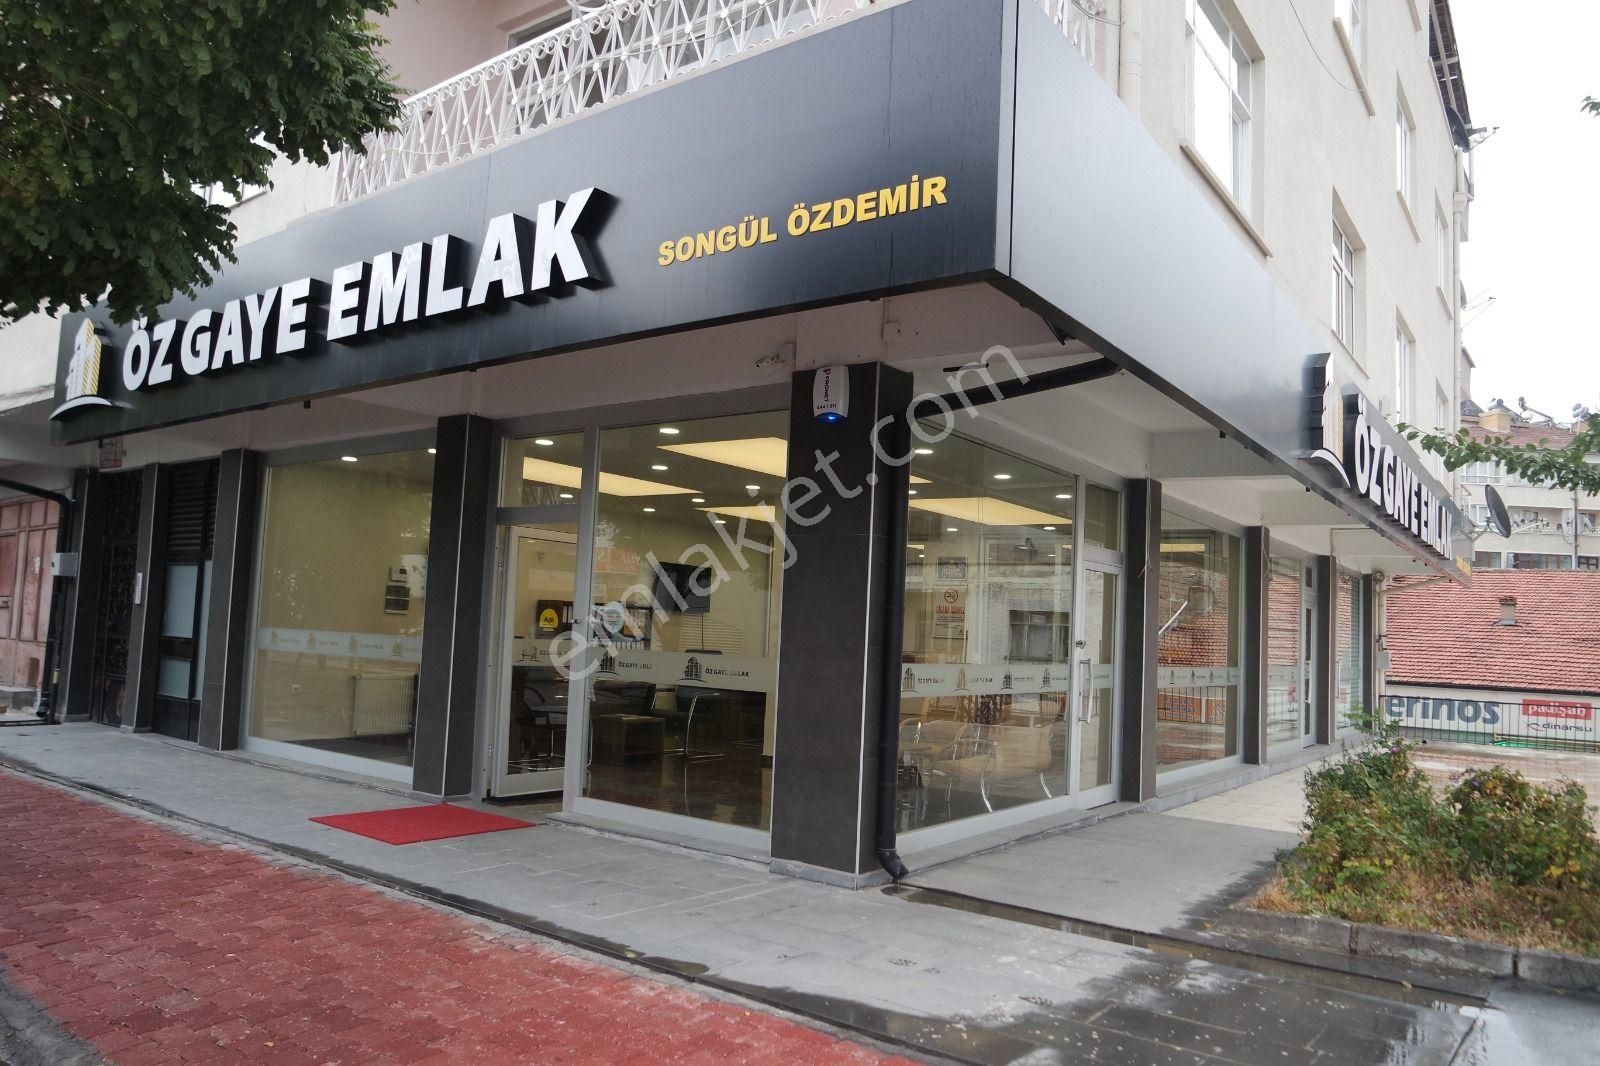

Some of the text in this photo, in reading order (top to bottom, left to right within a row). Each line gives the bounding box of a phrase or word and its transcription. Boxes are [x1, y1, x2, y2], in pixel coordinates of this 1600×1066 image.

[327, 187, 596, 340] EMLAK
[657, 174, 948, 267] SONGÜL ÖZDEMİR
[1542, 722, 1593, 733] dinarsu
